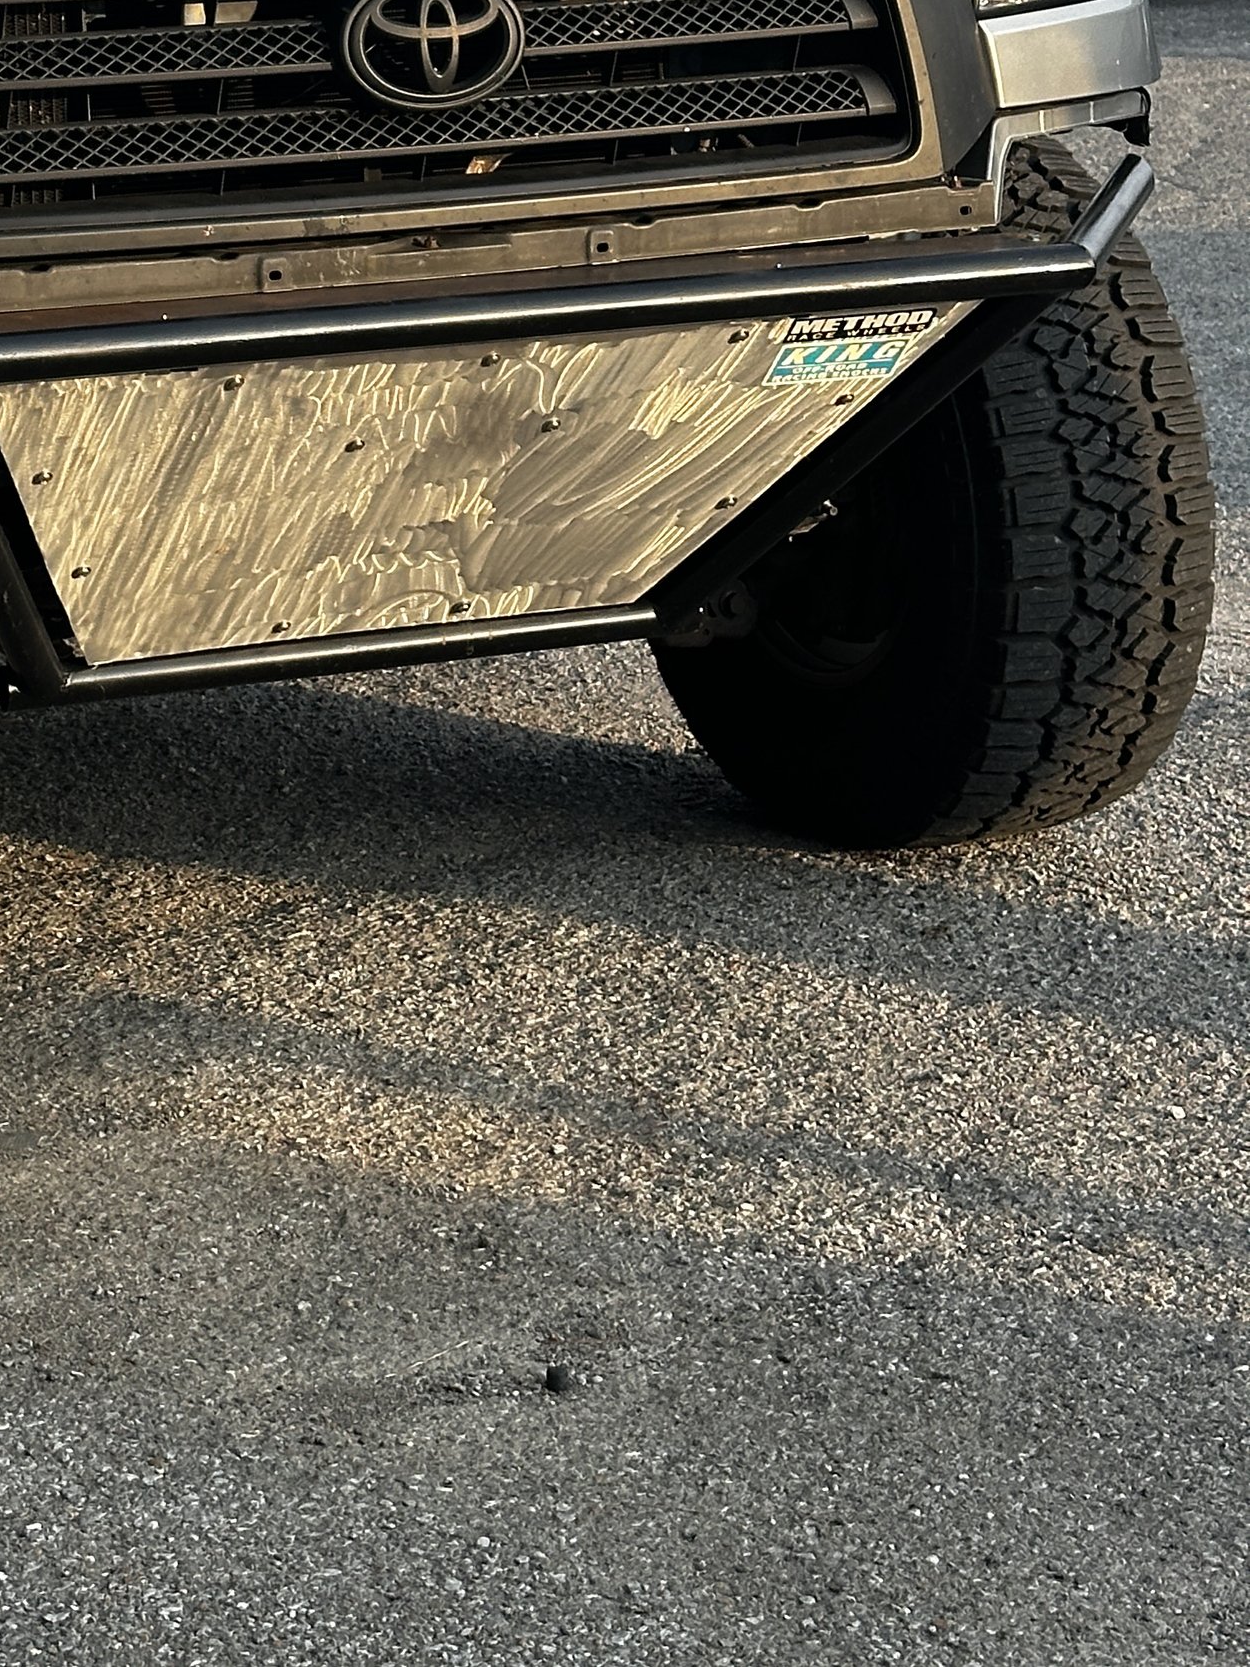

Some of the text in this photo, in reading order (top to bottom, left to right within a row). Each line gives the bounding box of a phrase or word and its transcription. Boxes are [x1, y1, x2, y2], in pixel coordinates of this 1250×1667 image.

[790, 310, 934, 335] METHOD
[786, 324, 926, 342] RACE WHEELS
[781, 341, 905, 365] KING
[771, 371, 828, 384] RACING
[792, 362, 868, 375] OFF-ROAD
